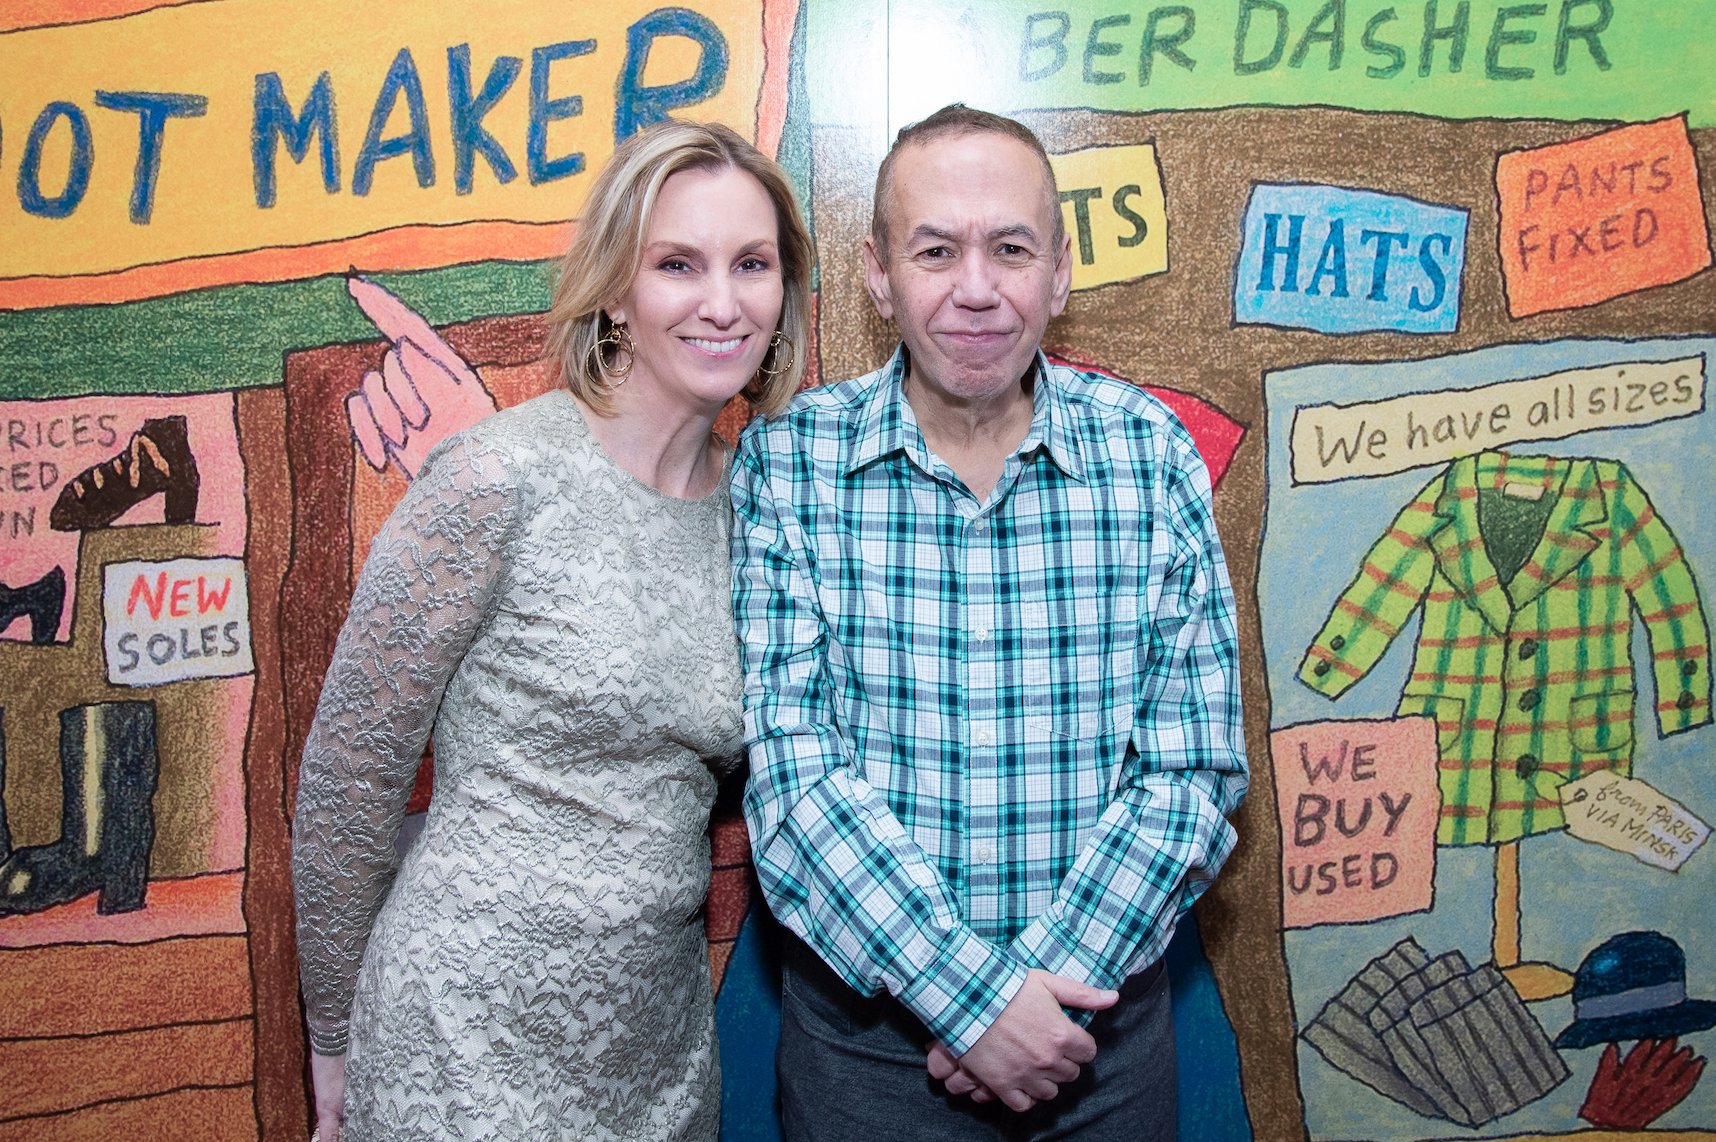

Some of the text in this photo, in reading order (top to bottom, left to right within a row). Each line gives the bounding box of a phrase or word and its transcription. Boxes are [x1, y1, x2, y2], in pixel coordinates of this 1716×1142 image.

[1017, 0, 1614, 88] BER DASHER
[0, 6, 730, 226] OT MAKER
[1522, 154, 1674, 211] PANTS
[1058, 183, 1148, 266] TS
[1516, 207, 1661, 272] FIXED
[1255, 211, 1454, 313] HATS
[0, 413, 118, 453] RICES
[1314, 370, 1694, 468] We have all sizes
[0, 461, 59, 492] ED
[0, 505, 36, 540] N
[126, 570, 232, 622] NEW
[116, 620, 241, 674] SOLES
[1298, 739, 1378, 786] WE
[1292, 790, 1412, 848] BUY
[1586, 803, 1679, 861] VIA MINSK
[1596, 780, 1699, 845] from PARIS
[1287, 852, 1399, 897] USED
